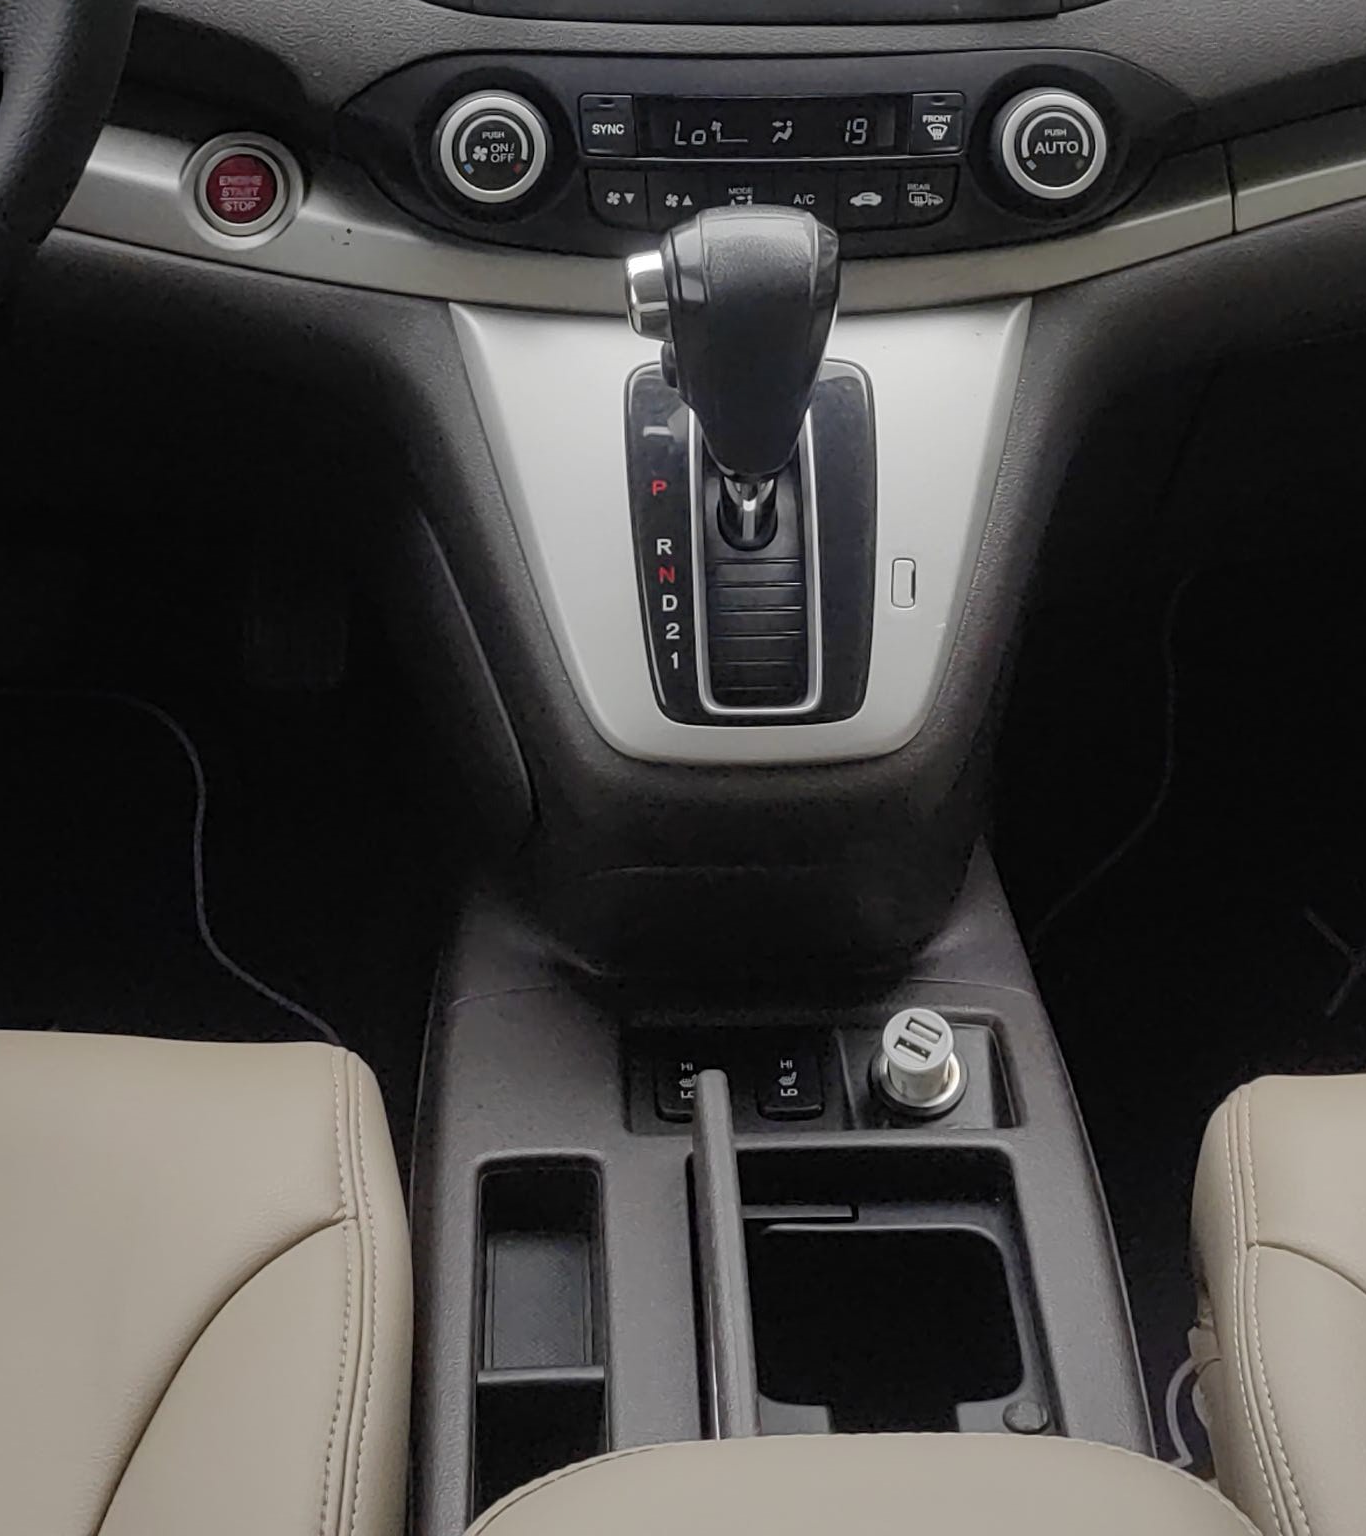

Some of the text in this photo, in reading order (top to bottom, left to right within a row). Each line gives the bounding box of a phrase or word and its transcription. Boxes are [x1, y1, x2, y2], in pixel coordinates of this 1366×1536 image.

[922, 114, 951, 124] FRONT
[592, 124, 625, 135] SYNC
[1034, 141, 1079, 155] AUTO
[490, 153, 515, 164] OFF
[223, 200, 257, 212] STOP
[793, 193, 816, 206] A/C
[651, 479, 668, 497] P
[656, 538, 673, 556] R
[658, 566, 676, 584] N
[662, 594, 678, 612] D
[665, 622, 681, 640] 2
[671, 651, 679, 670] 1
